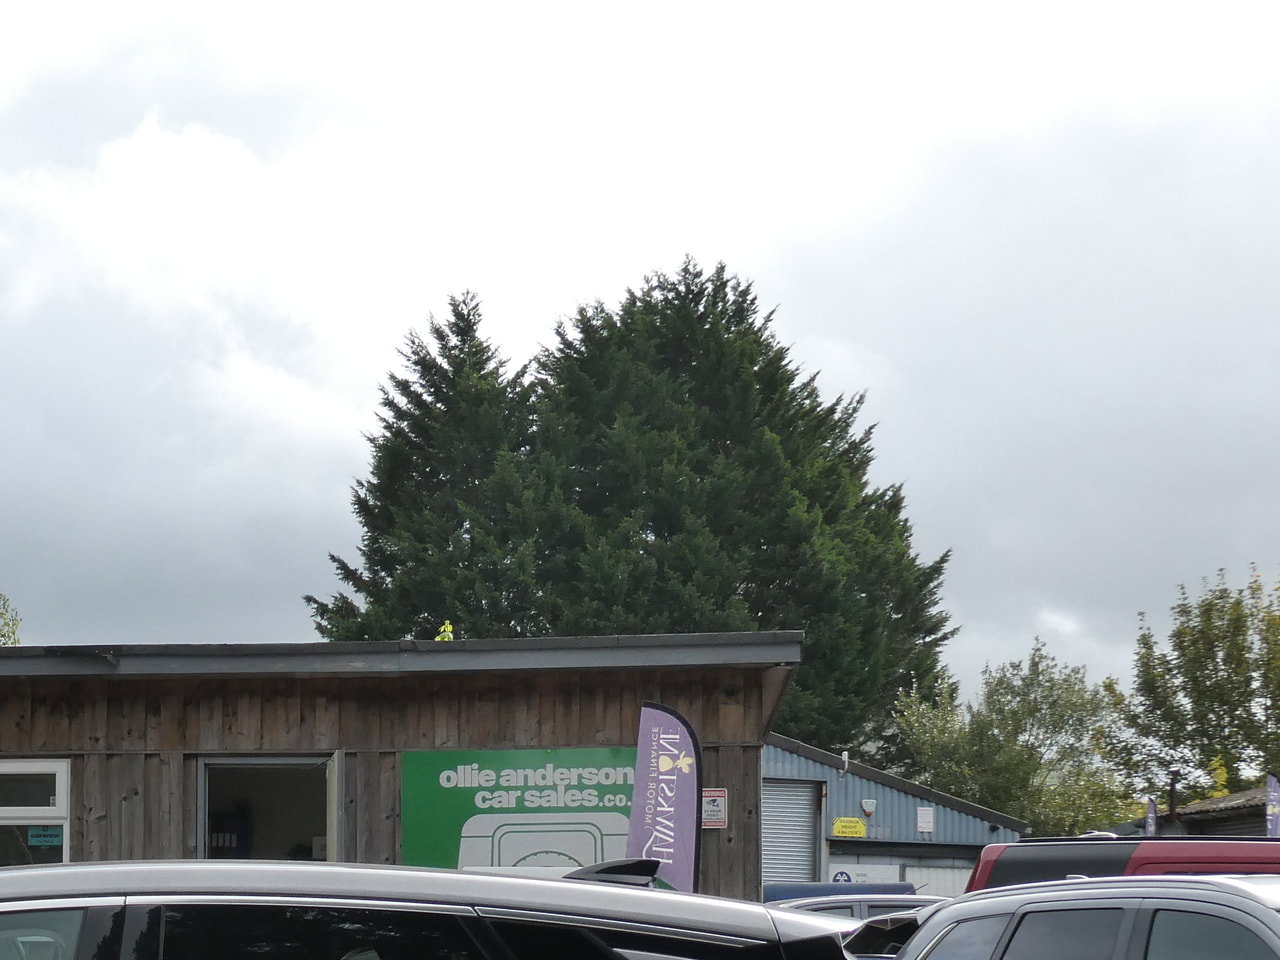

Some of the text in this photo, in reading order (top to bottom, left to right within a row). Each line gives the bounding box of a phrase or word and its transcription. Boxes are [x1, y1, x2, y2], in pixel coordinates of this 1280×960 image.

[439, 763, 635, 788] ollie anderson
[474, 790, 522, 808] car
